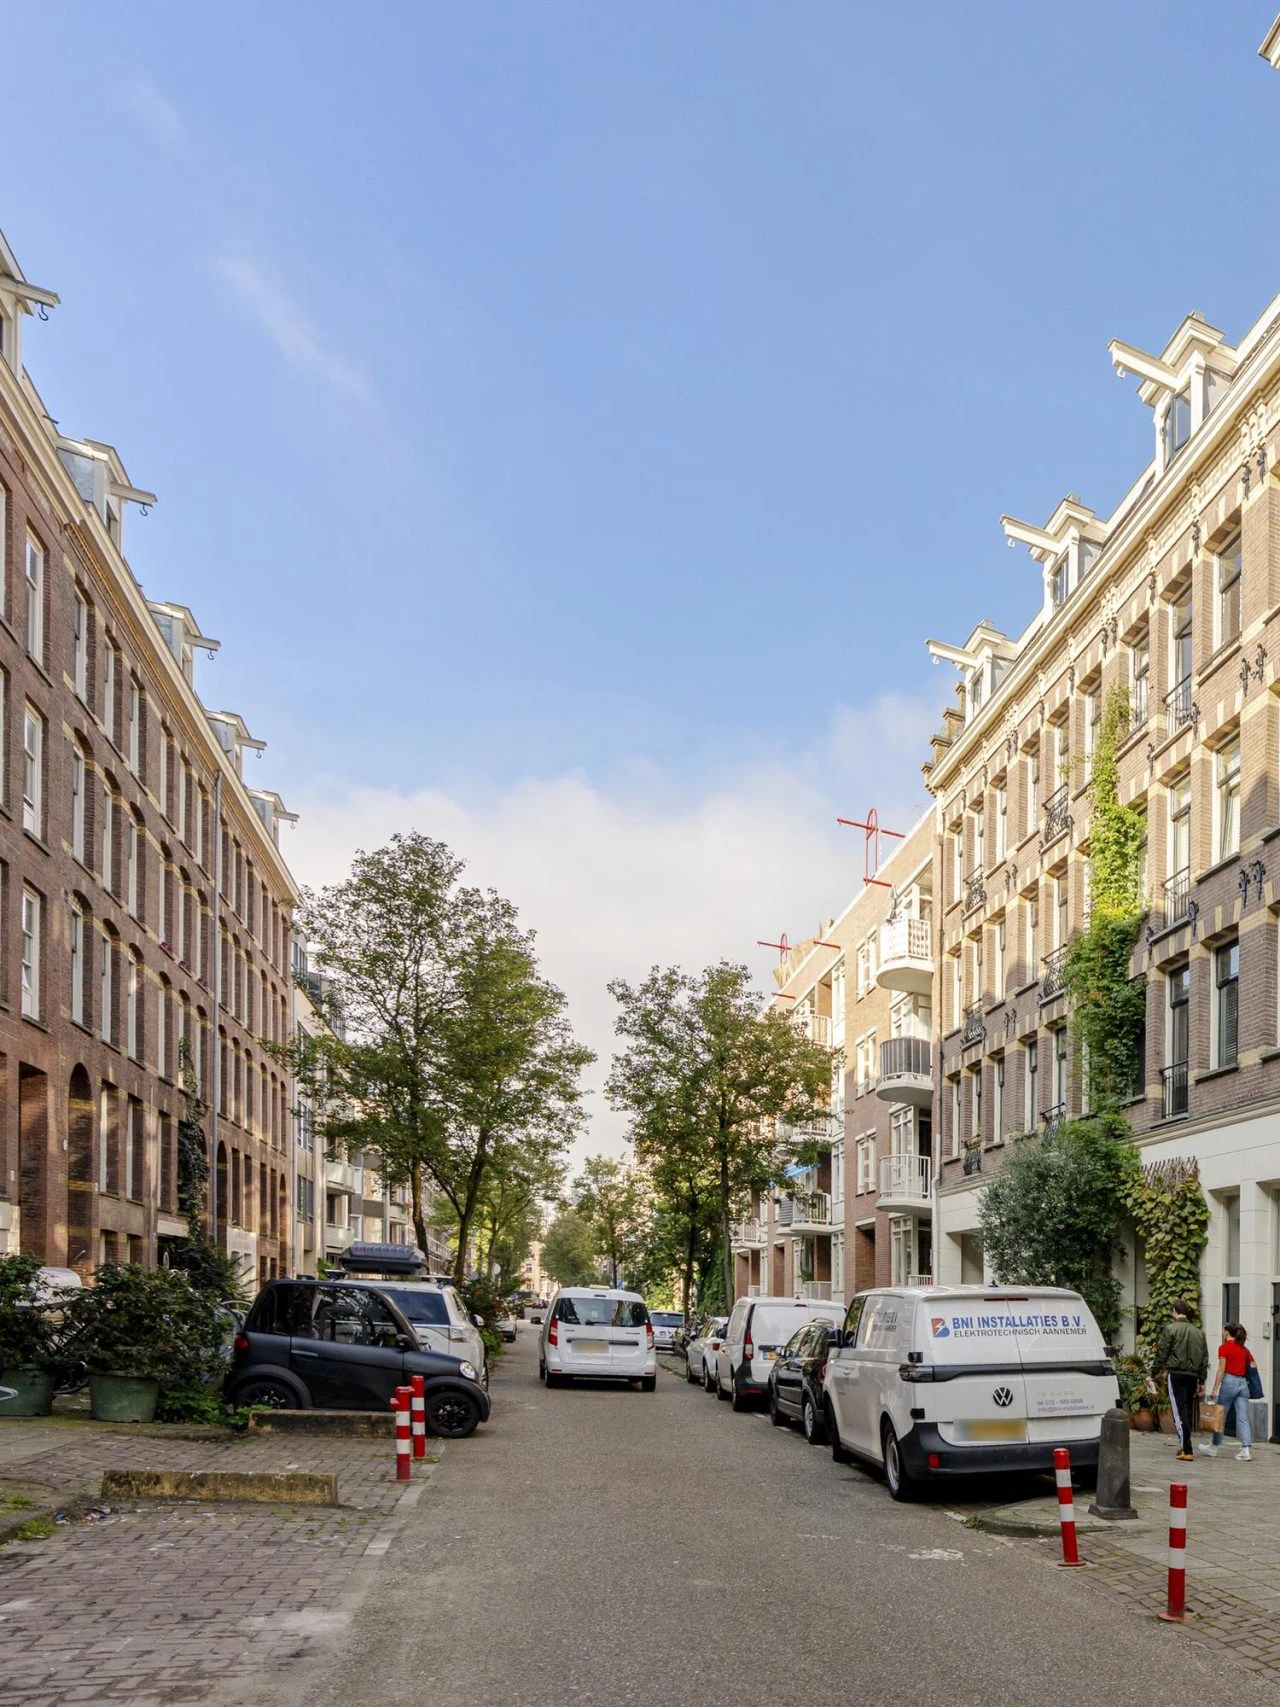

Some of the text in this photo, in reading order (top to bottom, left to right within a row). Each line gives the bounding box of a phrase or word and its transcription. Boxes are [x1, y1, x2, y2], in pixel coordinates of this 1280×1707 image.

[952, 1317, 974, 1329] BNI
[978, 1315, 1058, 1329] INSTALLATIES
[954, 1328, 1087, 1338] ELEKTROTECHNISCH AANNEMER
